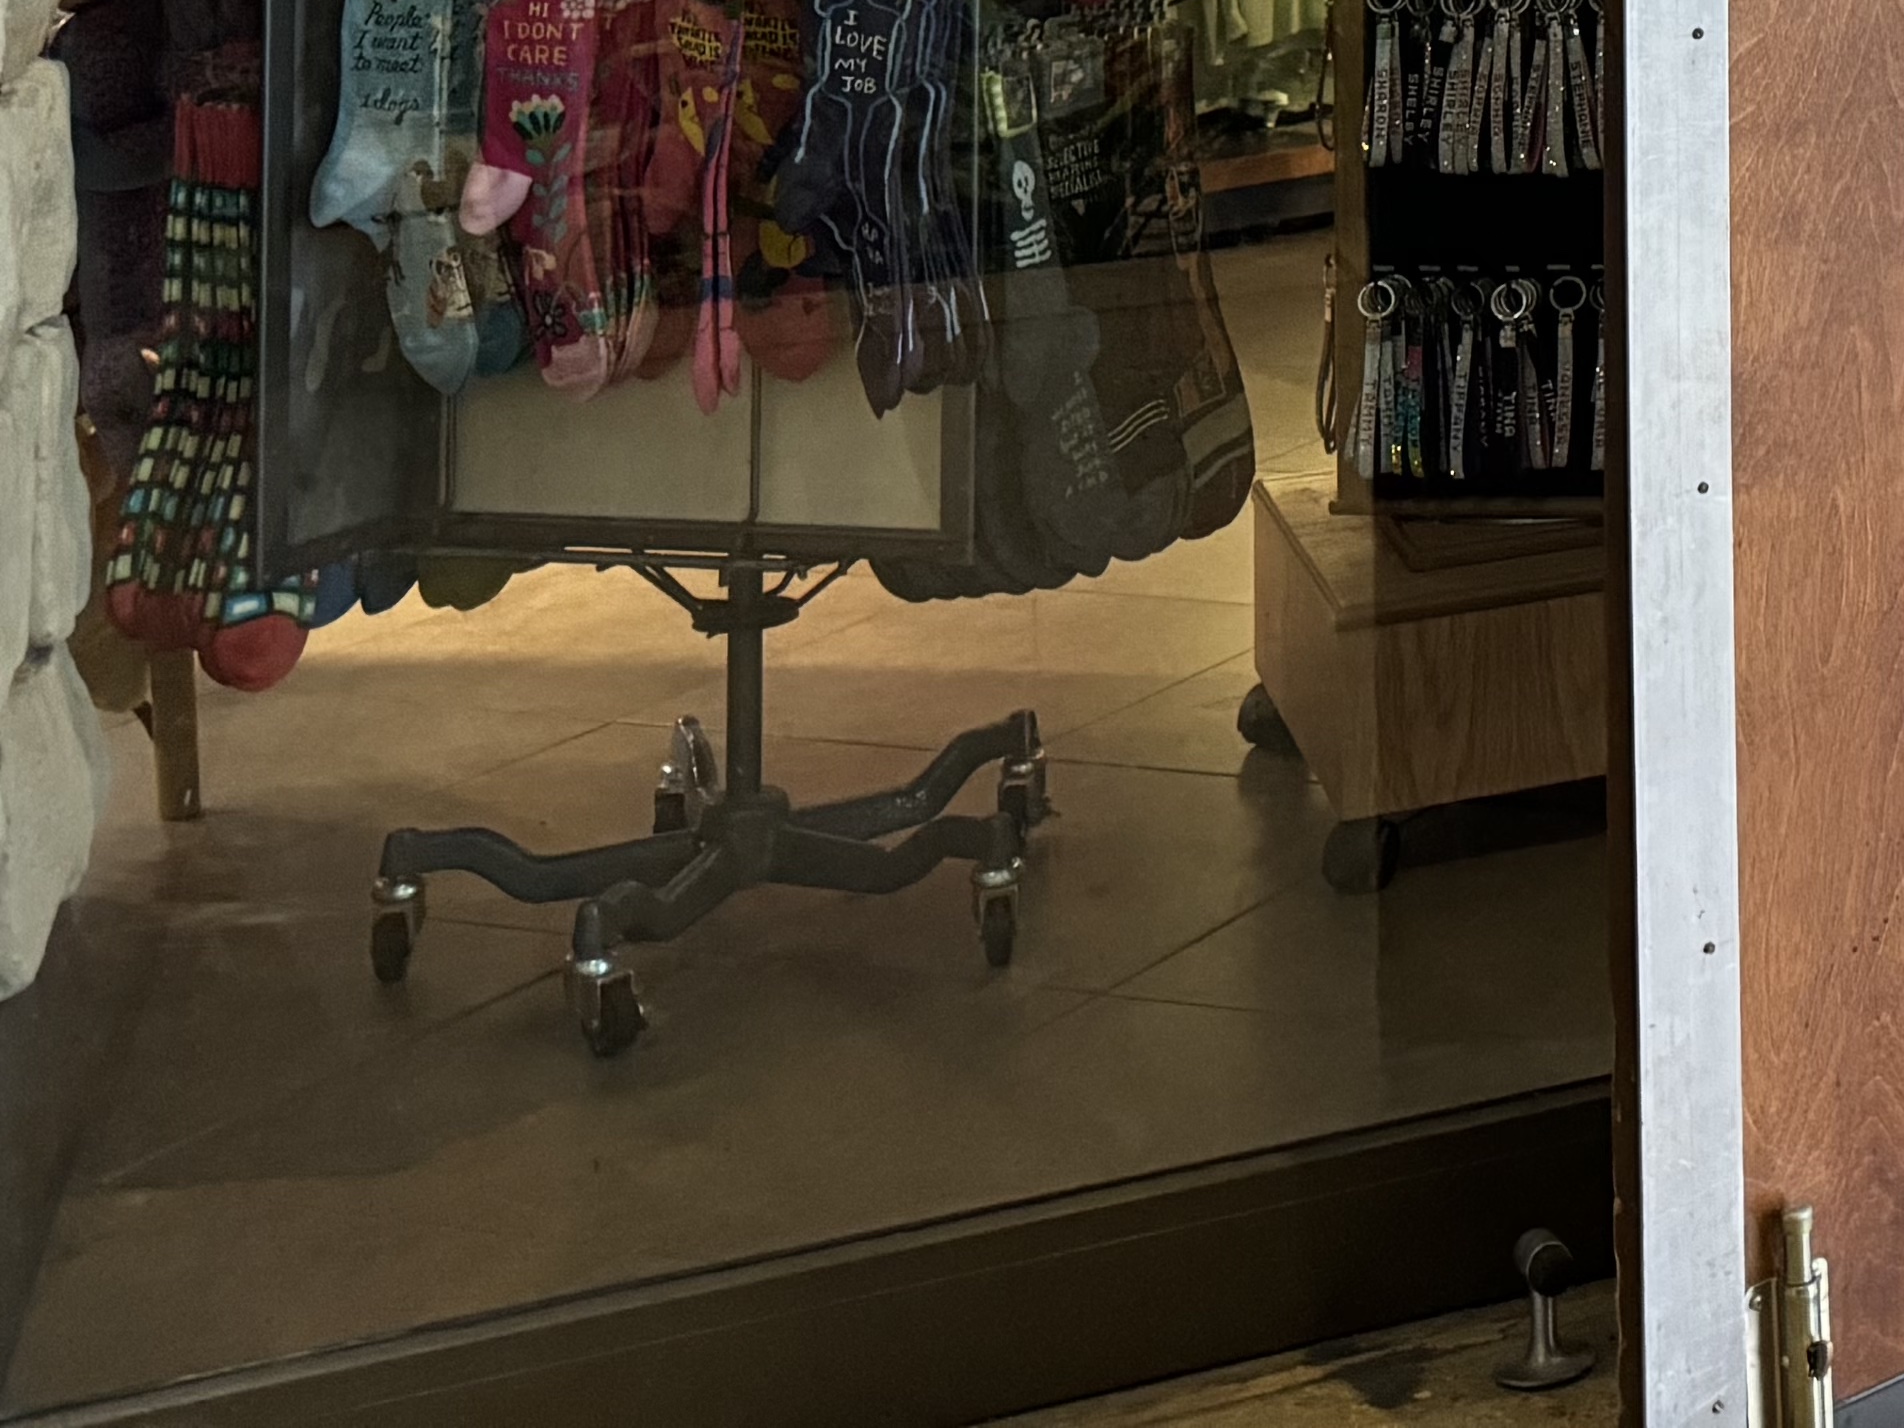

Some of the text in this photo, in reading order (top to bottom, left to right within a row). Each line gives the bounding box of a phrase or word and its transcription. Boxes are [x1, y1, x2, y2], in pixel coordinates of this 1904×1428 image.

[527, 0, 550, 18] HI
[842, 10, 859, 27] I
[506, 42, 569, 66] CARE
[834, 27, 887, 58] LOVE
[496, 66, 580, 89] THANKS
[834, 57, 867, 73] MY
[840, 75, 878, 95] JOB
[1373, 68, 1389, 140] SHARON
[1404, 72, 1420, 146] SHELBY
[1418, 65, 1445, 144] SHIRLEY
[1570, 60, 1589, 150] STEPHANIE
[1503, 391, 1517, 438] TINA
